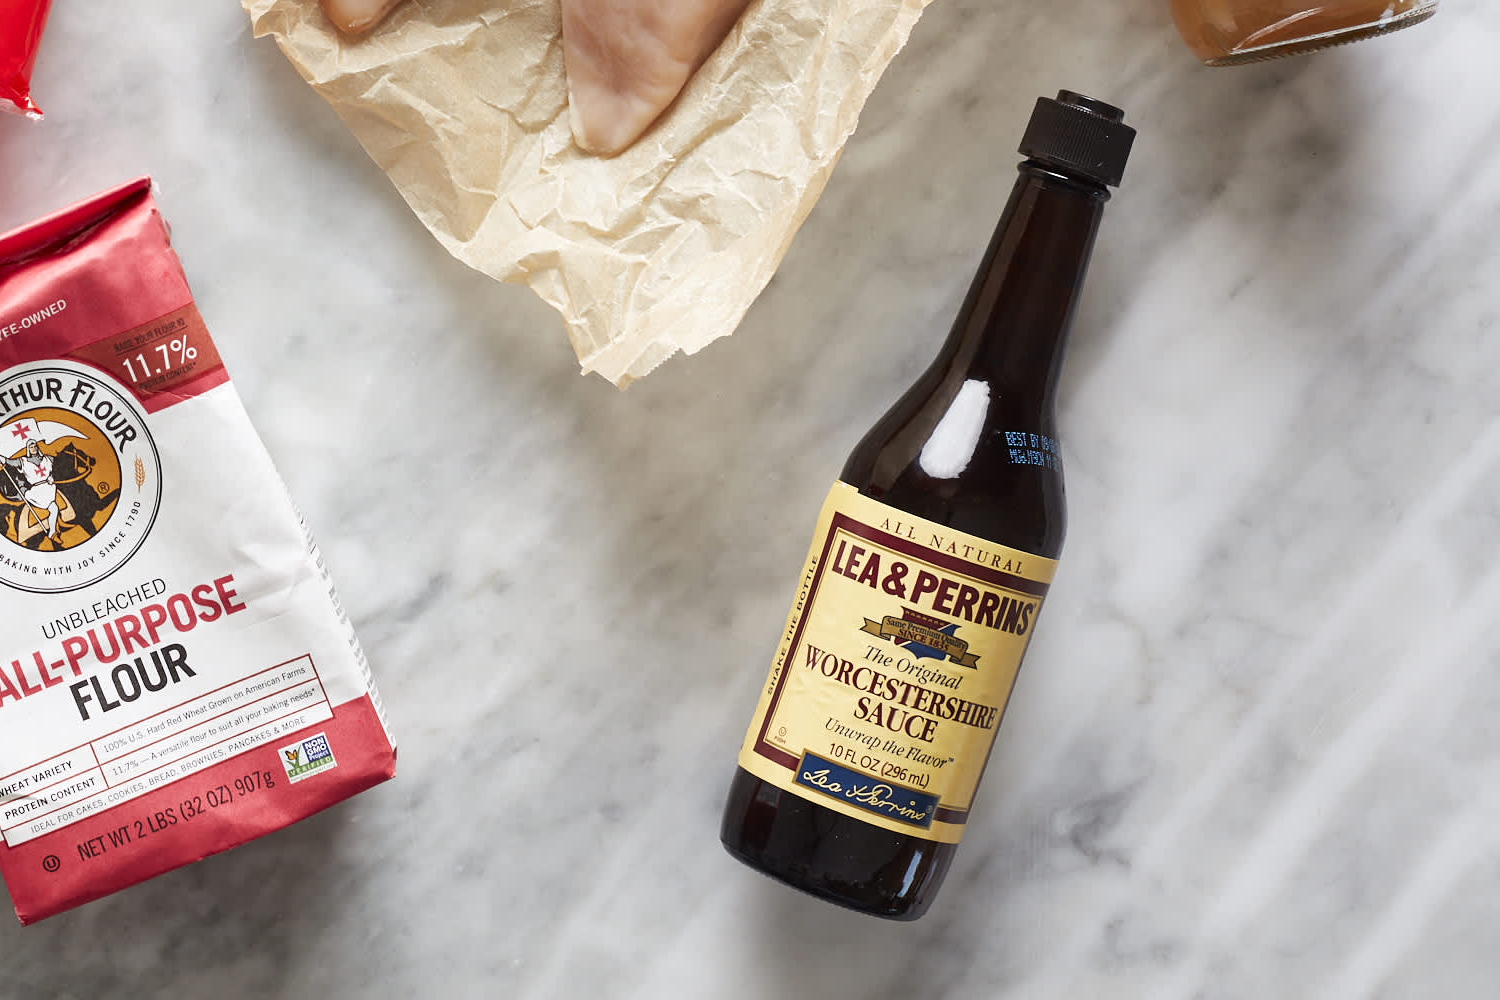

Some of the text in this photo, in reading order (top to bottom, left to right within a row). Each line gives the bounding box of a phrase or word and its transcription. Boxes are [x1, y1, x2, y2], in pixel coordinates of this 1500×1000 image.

[123, 334, 197, 382] 11.7%
[69, 380, 138, 451] FLOUR
[43, 565, 73, 575] WITH
[77, 556, 96, 570] JOY
[99, 530, 127, 558] SINCE
[125, 500, 142, 527] 1790
[880, 518, 1023, 575] ALL NATURAL
[42, 578, 167, 640] UNBLEACHED
[797, 555, 818, 611] BOTTLE
[898, 630, 927, 644] SINCE
[69, 643, 197, 721] FLOUR
[805, 644, 998, 730] WORCESTERSHIRE
[864, 645, 963, 690] The Original
[146, 666, 306, 735] Hard Red Wheat Grown American Farms
[263, 698, 289, 715] baking
[854, 697, 938, 743] SAUCE
[825, 717, 905, 756] Unwrap the
[30, 715, 306, 834] IDEAL FOR BROWNIES, PANCAKES MORE
[32, 760, 73, 782] VARIETY
[803, 770, 841, 794] Lea
[829, 743, 929, 788] 10 FL OZ (296 mL)
[5, 777, 96, 820] PROTEIN CONTENT
[76, 833, 108, 862] NET
[108, 826, 133, 850] WT
[133, 820, 148, 840] 2
[147, 807, 179, 835] LBS
[178, 794, 207, 822] (32
[206, 783, 234, 812] OZ)
[234, 769, 276, 798] 907g
